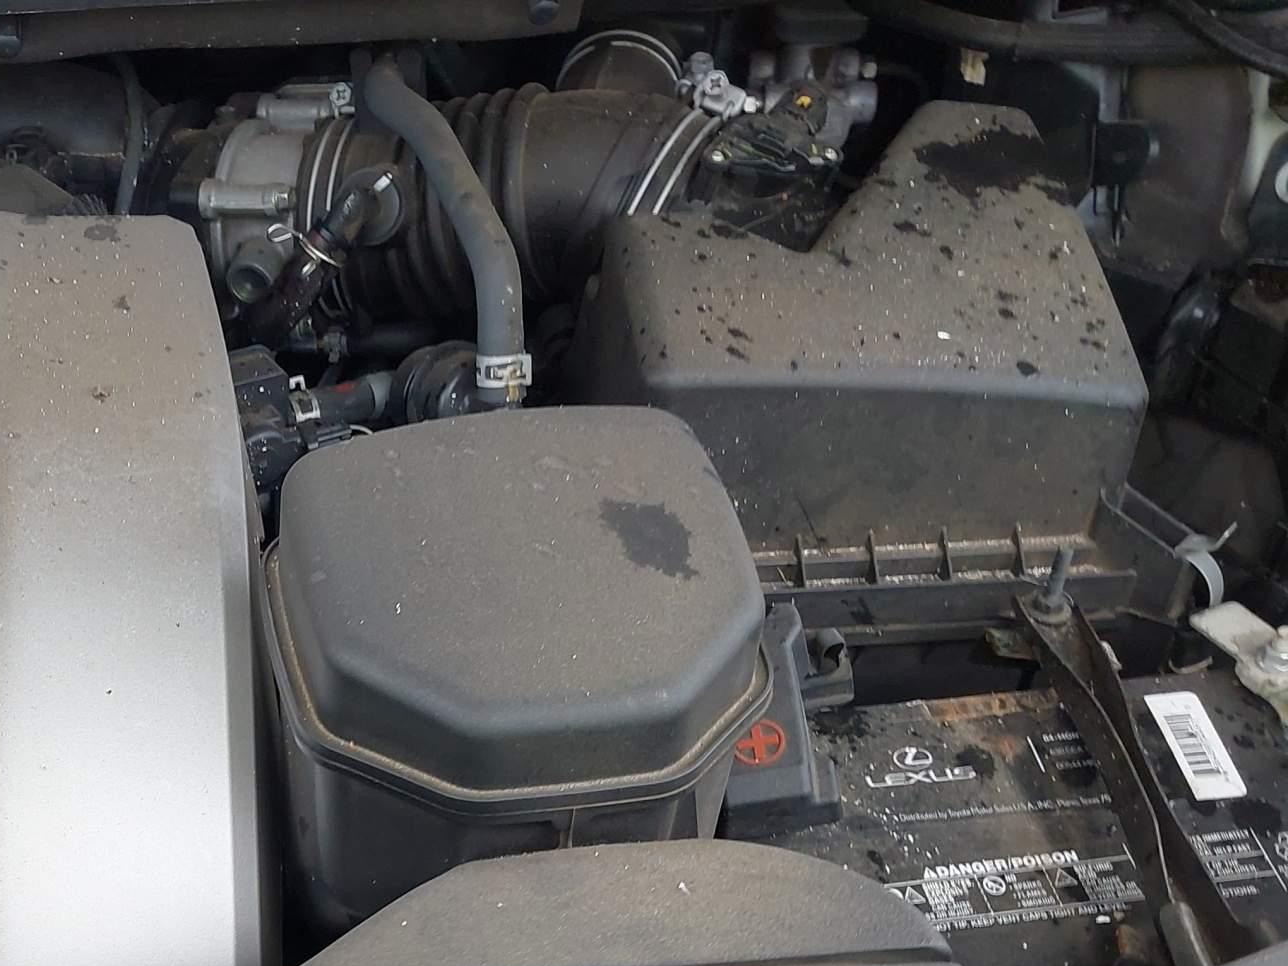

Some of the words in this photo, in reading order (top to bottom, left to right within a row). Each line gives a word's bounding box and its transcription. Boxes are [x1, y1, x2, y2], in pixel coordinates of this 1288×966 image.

[865, 765, 977, 788] LEXUS
[948, 808, 971, 819] Toyota
[996, 914, 1020, 925] VENT
